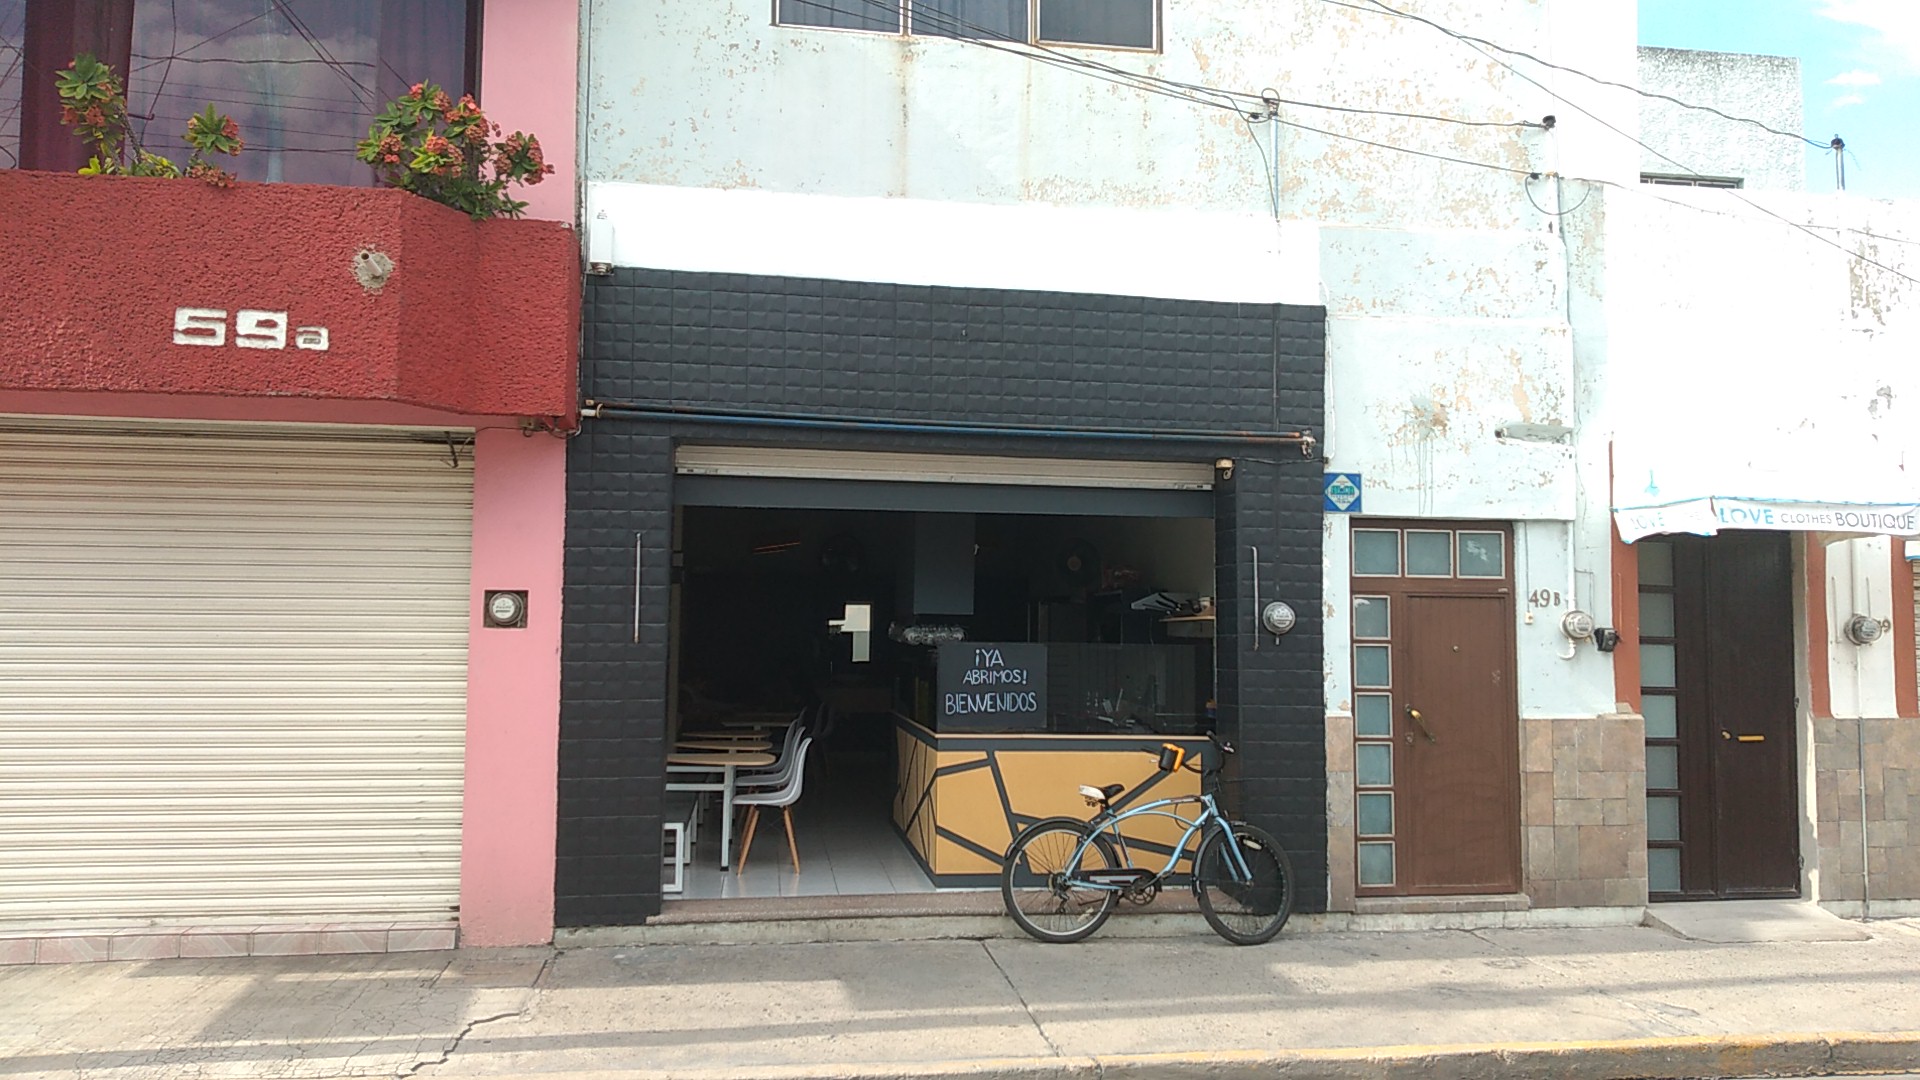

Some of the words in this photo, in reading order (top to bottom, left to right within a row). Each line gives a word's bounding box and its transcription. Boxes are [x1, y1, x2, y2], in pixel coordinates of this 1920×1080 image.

[1719, 507, 1774, 525] LOVE
[1780, 512, 1833, 525] CLOTHES
[1835, 512, 1915, 530] BOUTIQUE
[962, 669, 1027, 686] ABRIMOS!
[945, 691, 1038, 715] BIENVENIDOS
